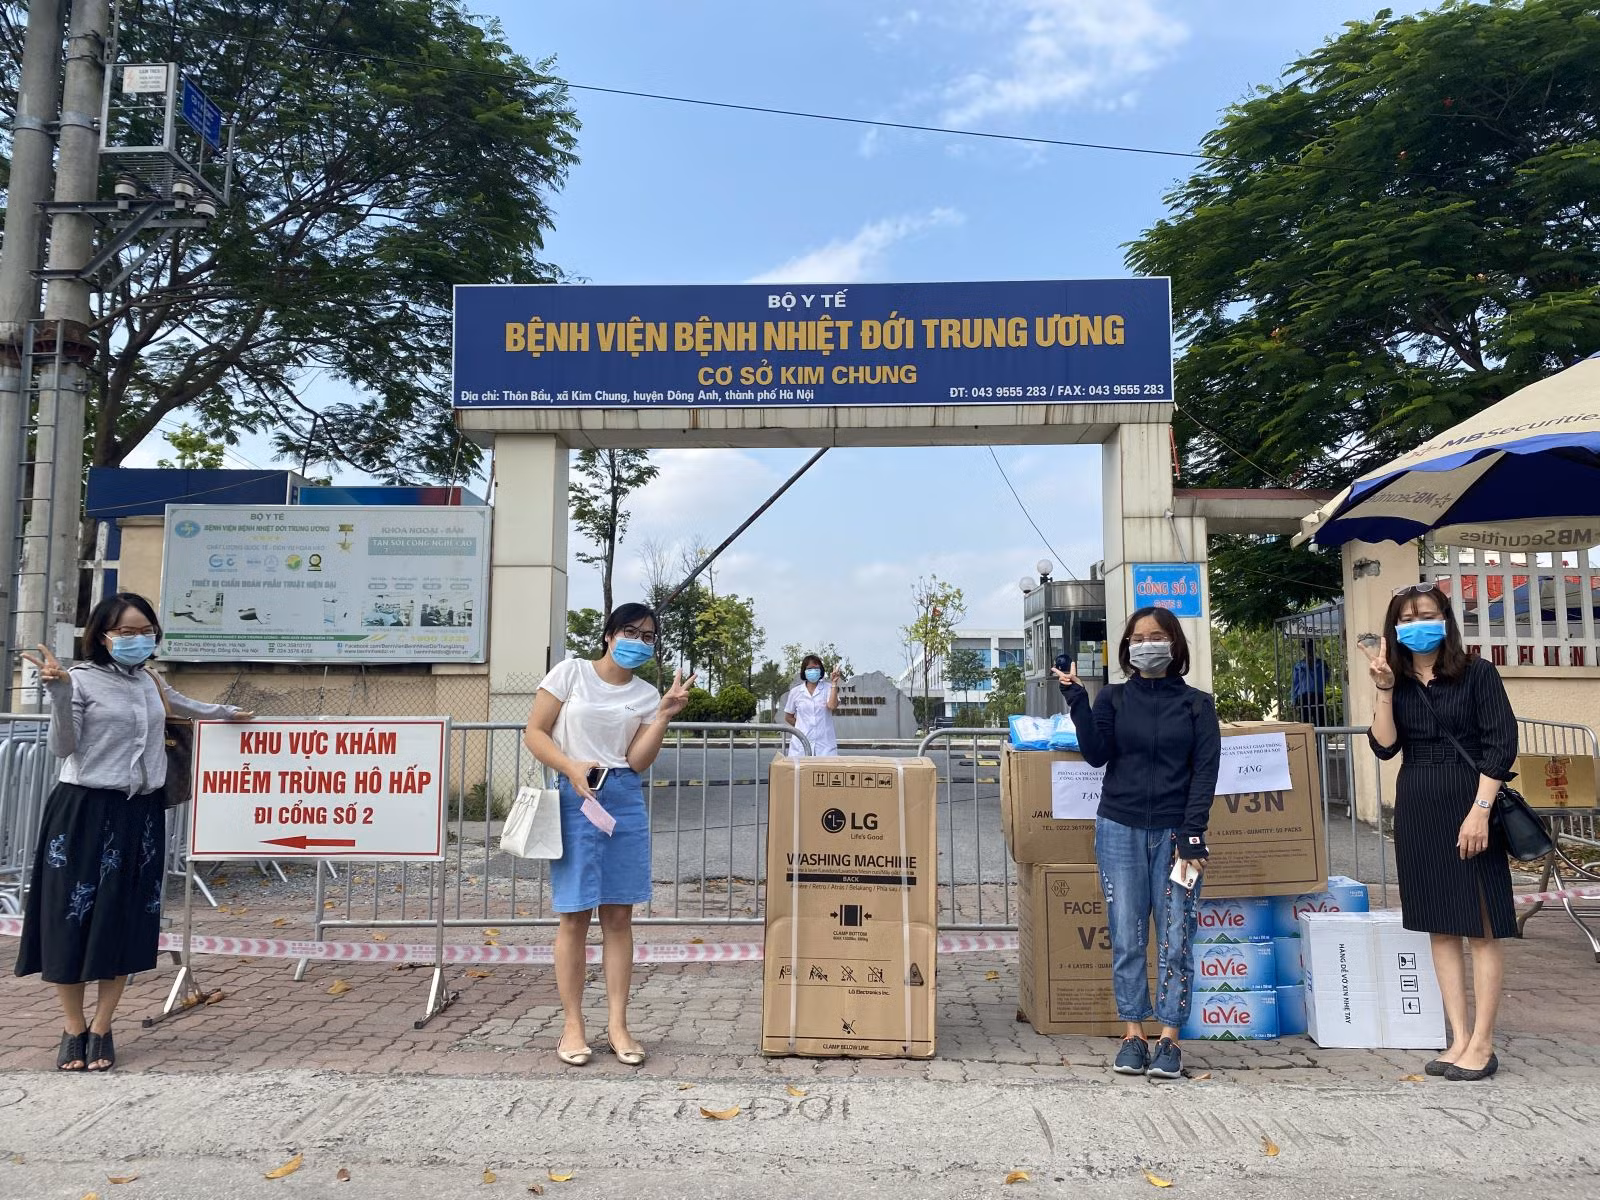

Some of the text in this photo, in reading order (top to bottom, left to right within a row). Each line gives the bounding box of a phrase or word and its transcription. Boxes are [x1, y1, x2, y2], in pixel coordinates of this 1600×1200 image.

[768, 288, 848, 311] BỘ Y TẾ
[505, 311, 1125, 358] BỆNH VIỆN BỆNH NHIỆT ĐỚI TRUNG ƯƠNG
[698, 358, 918, 386] CƠ SỞ KIM CHUNG
[461, 388, 814, 403] Địa chỉ: Thôn Bầu, xã Kim Chung, huyện Đông Anh, thành phố Hà Nội
[949, 384, 1165, 398] ĐT: 043 9555 283 / FAX: 043 9555 283
[1138, 575, 1198, 595] CỔNG SỐ 3
[240, 727, 397, 759] KHU VỰC KHÁM
[202, 762, 432, 794] NHIỄM TRÙNG HÔ HẤP
[1238, 764, 1262, 775] TẶNG
[1081, 792, 1100, 801] TẶN
[1224, 790, 1285, 814] V3N
[254, 799, 373, 825] ĐI CỔNG SỐ 2
[851, 812, 878, 830] LG
[786, 852, 851, 867] WASHING
[1064, 901, 1102, 915] FACE
[1198, 909, 1245, 927] laVie
[1077, 926, 1113, 950] V3
[1201, 958, 1248, 976] laVie
[1203, 1005, 1251, 1024] laVie
